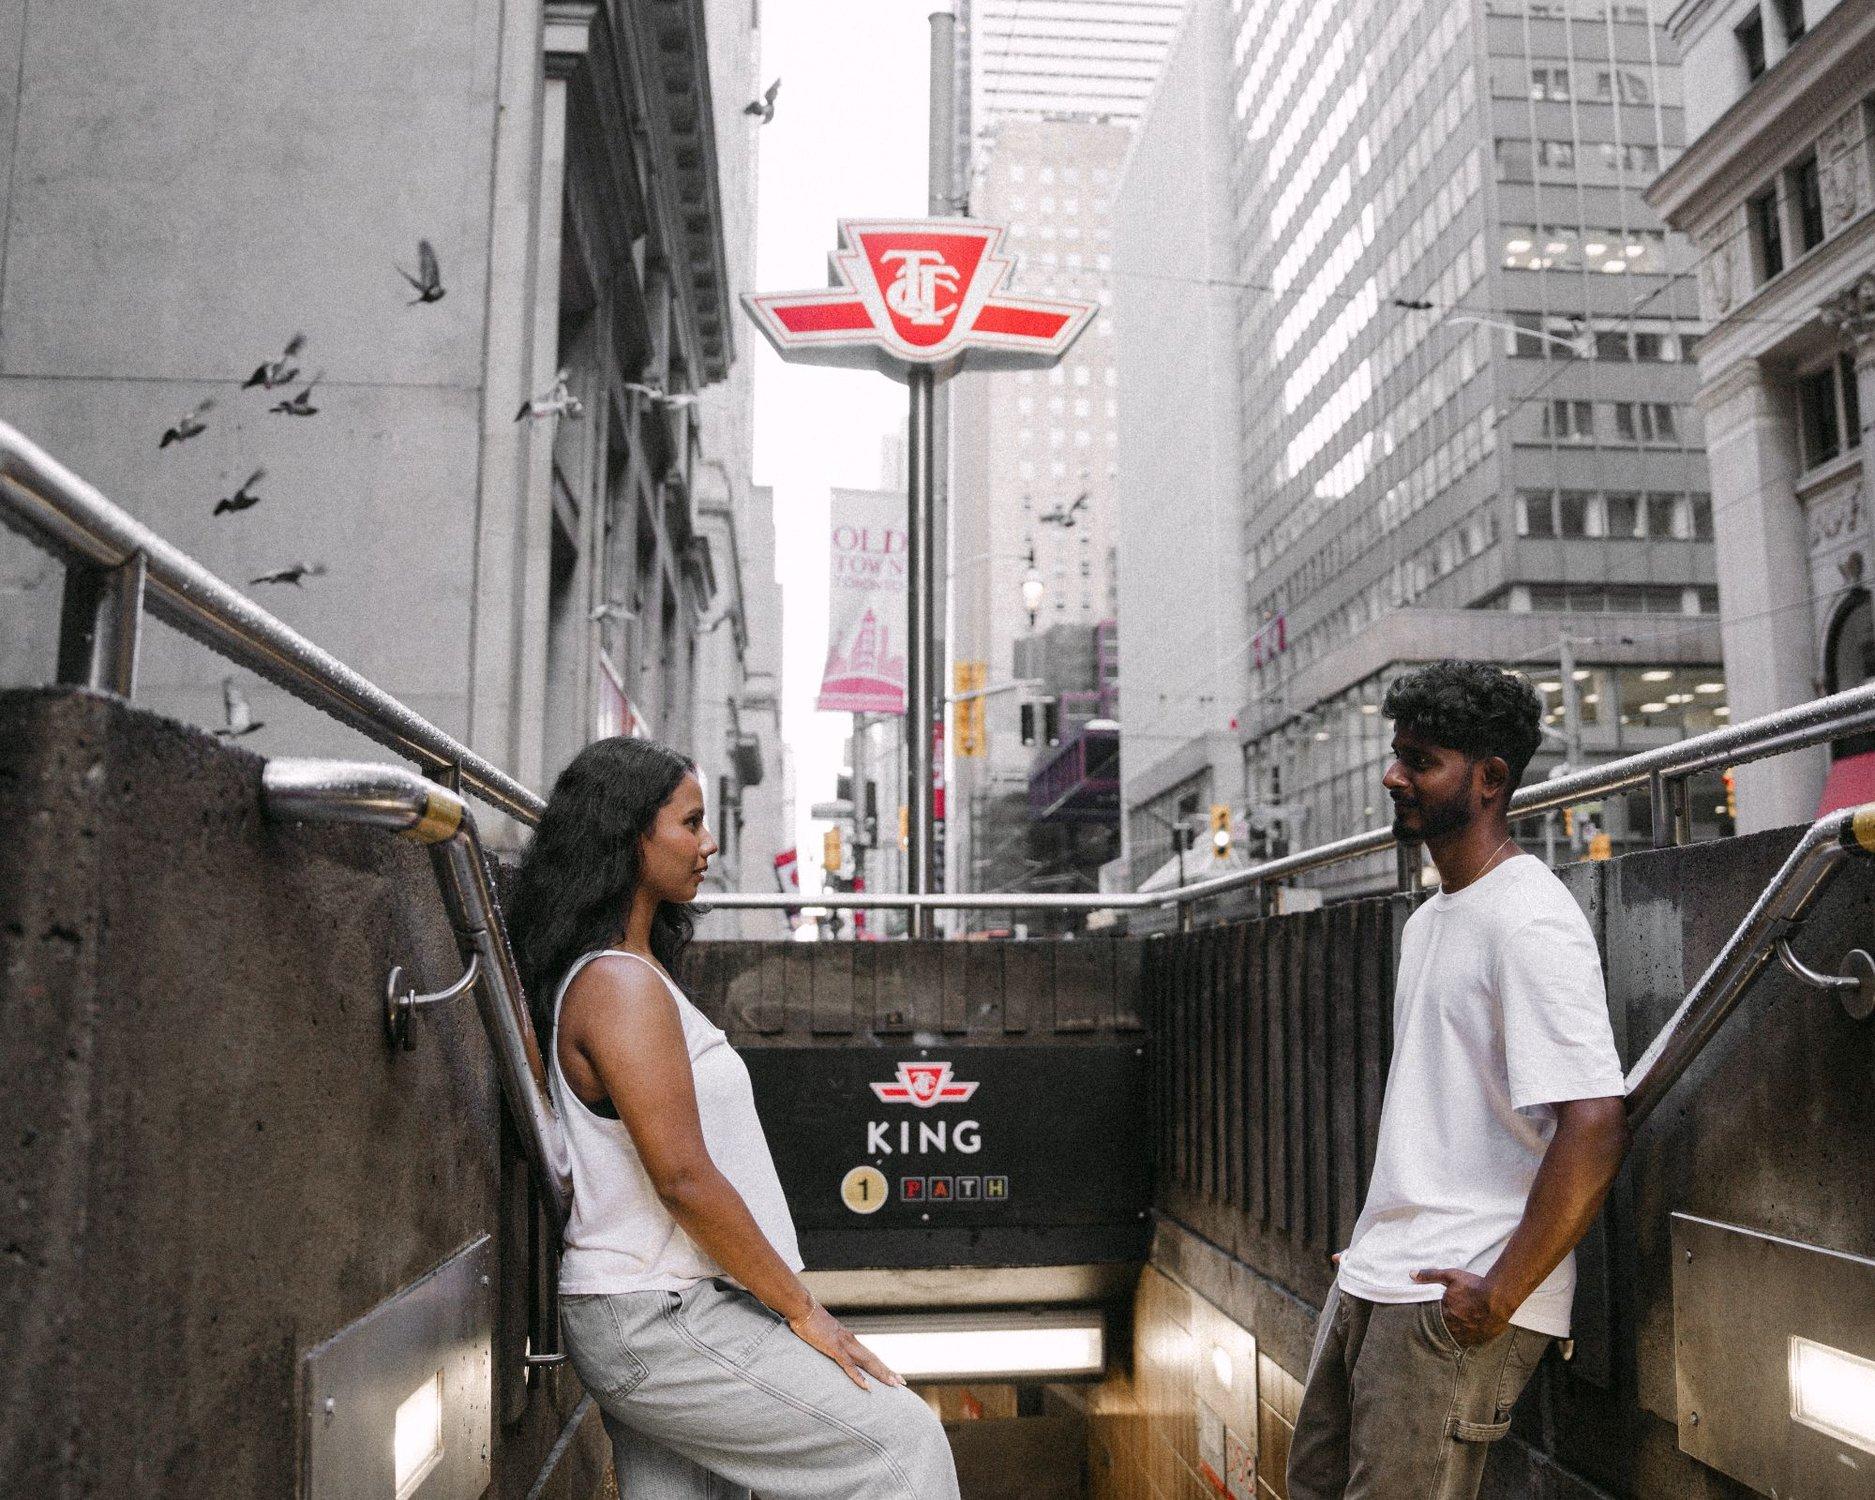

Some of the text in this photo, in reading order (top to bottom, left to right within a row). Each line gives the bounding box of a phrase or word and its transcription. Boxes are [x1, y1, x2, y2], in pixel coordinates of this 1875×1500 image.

[878, 249, 961, 326] TTC
[867, 1119, 982, 1155] KING
[858, 1178, 869, 1201] 1
[903, 1179, 1003, 1198] PATH
